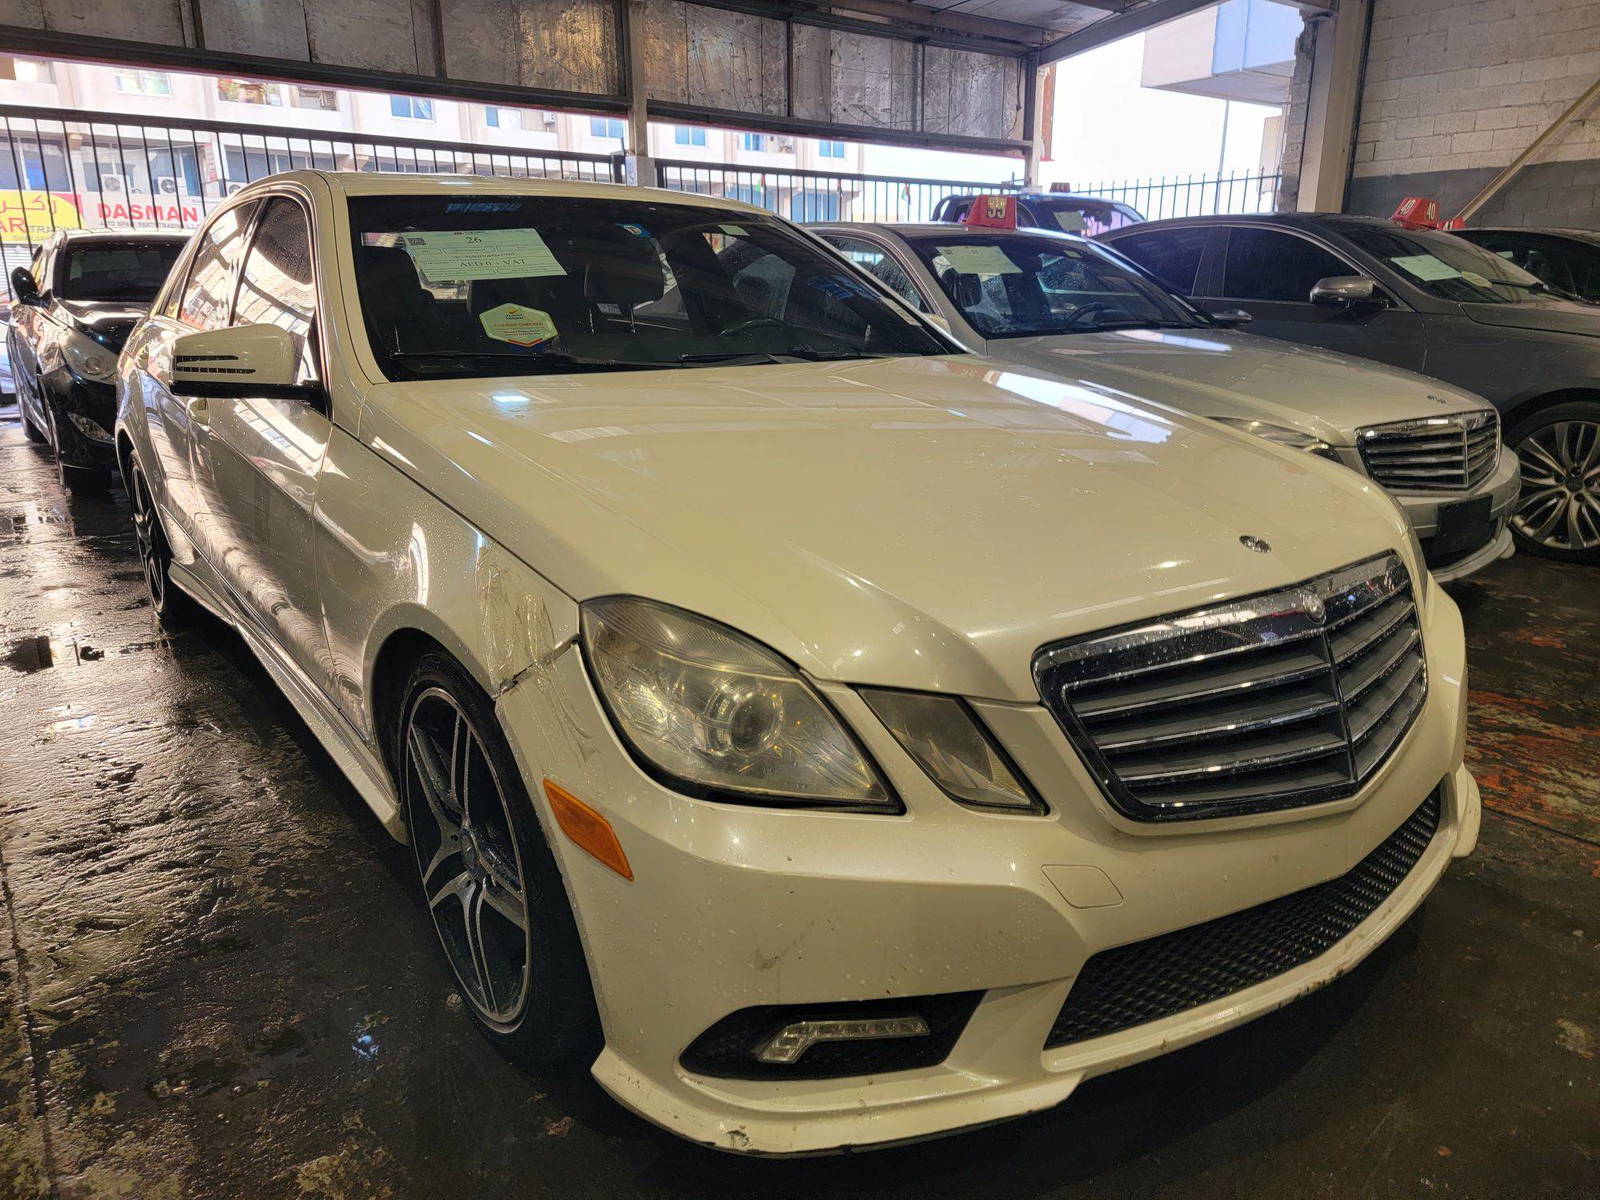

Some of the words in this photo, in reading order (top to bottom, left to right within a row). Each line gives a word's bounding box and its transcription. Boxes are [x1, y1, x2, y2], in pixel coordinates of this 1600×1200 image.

[97, 203, 198, 222] DASMAN
[1400, 199, 1416, 215] 40
[1426, 202, 1436, 220] 40
[466, 236, 482, 244] 26
